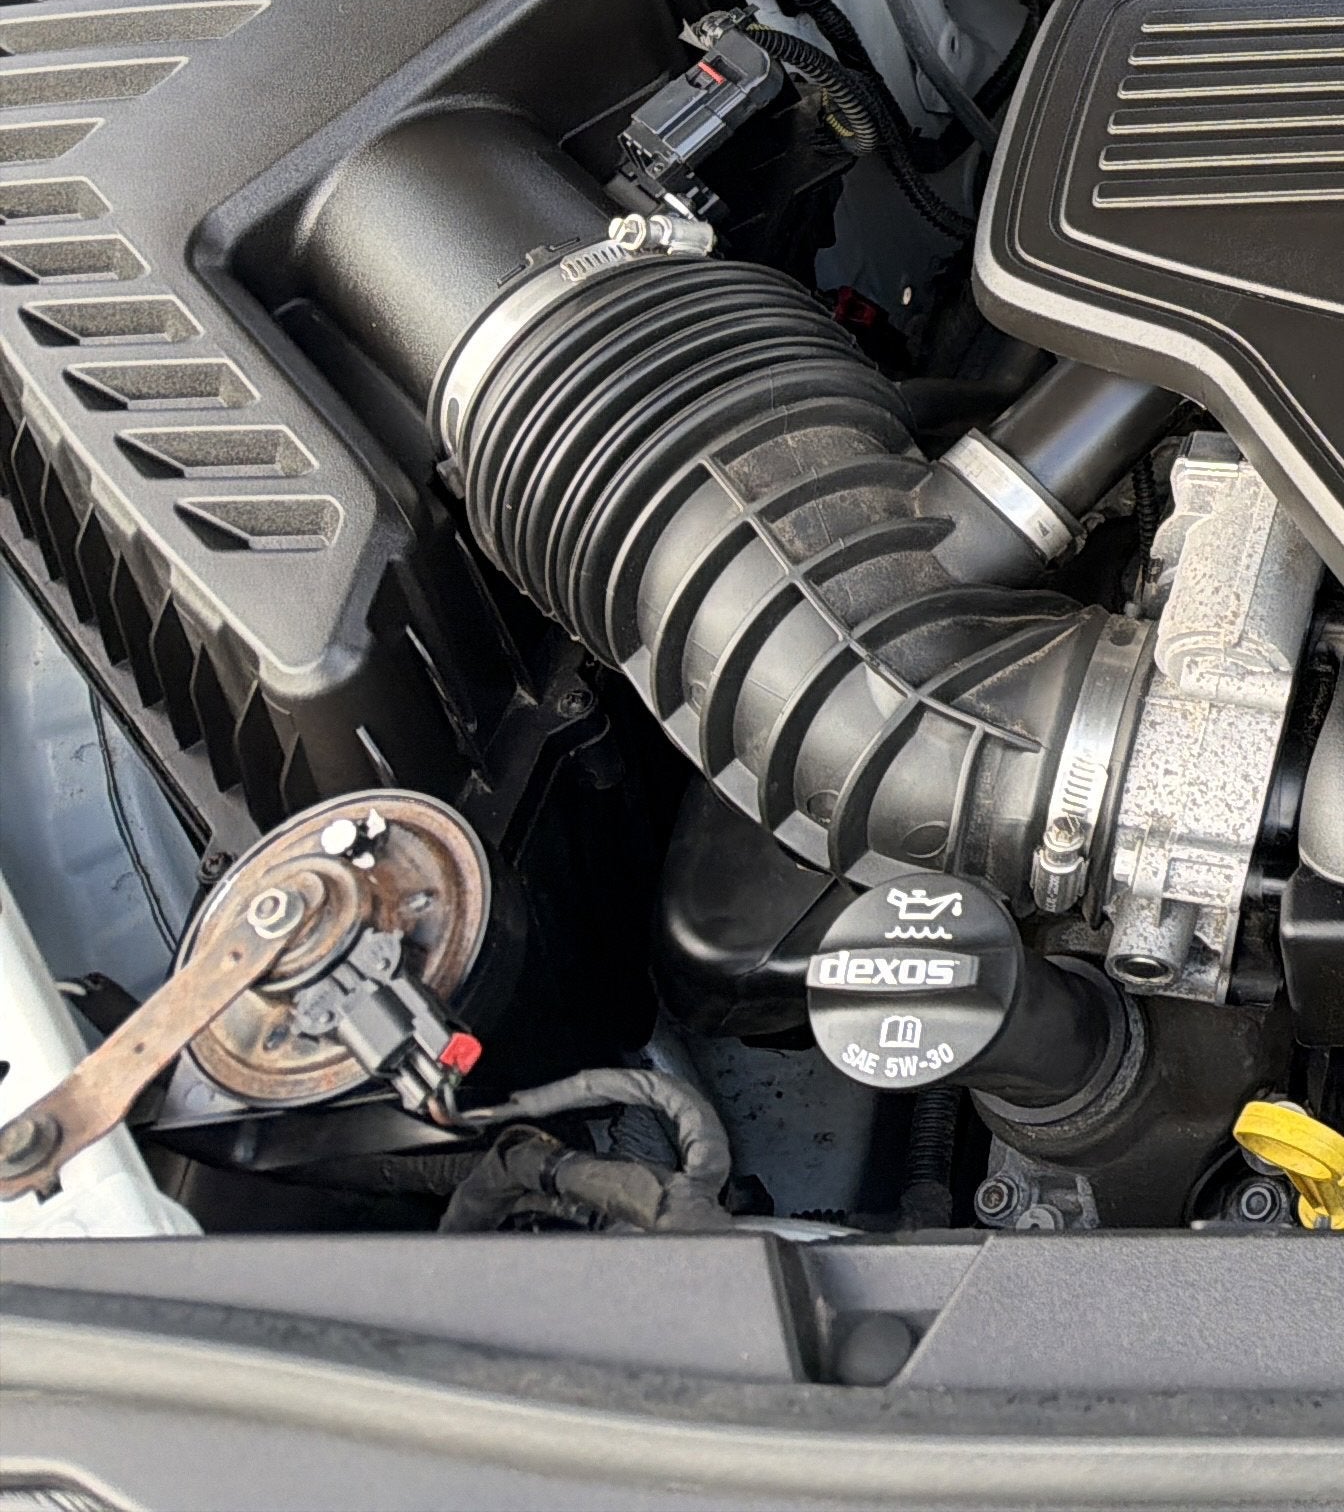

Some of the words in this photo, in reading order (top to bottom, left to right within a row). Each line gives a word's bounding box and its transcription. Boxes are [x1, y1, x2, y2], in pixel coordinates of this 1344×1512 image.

[819, 950, 955, 985] dexos
[842, 1044, 880, 1075] SAE
[885, 1043, 954, 1078] 5W-30
